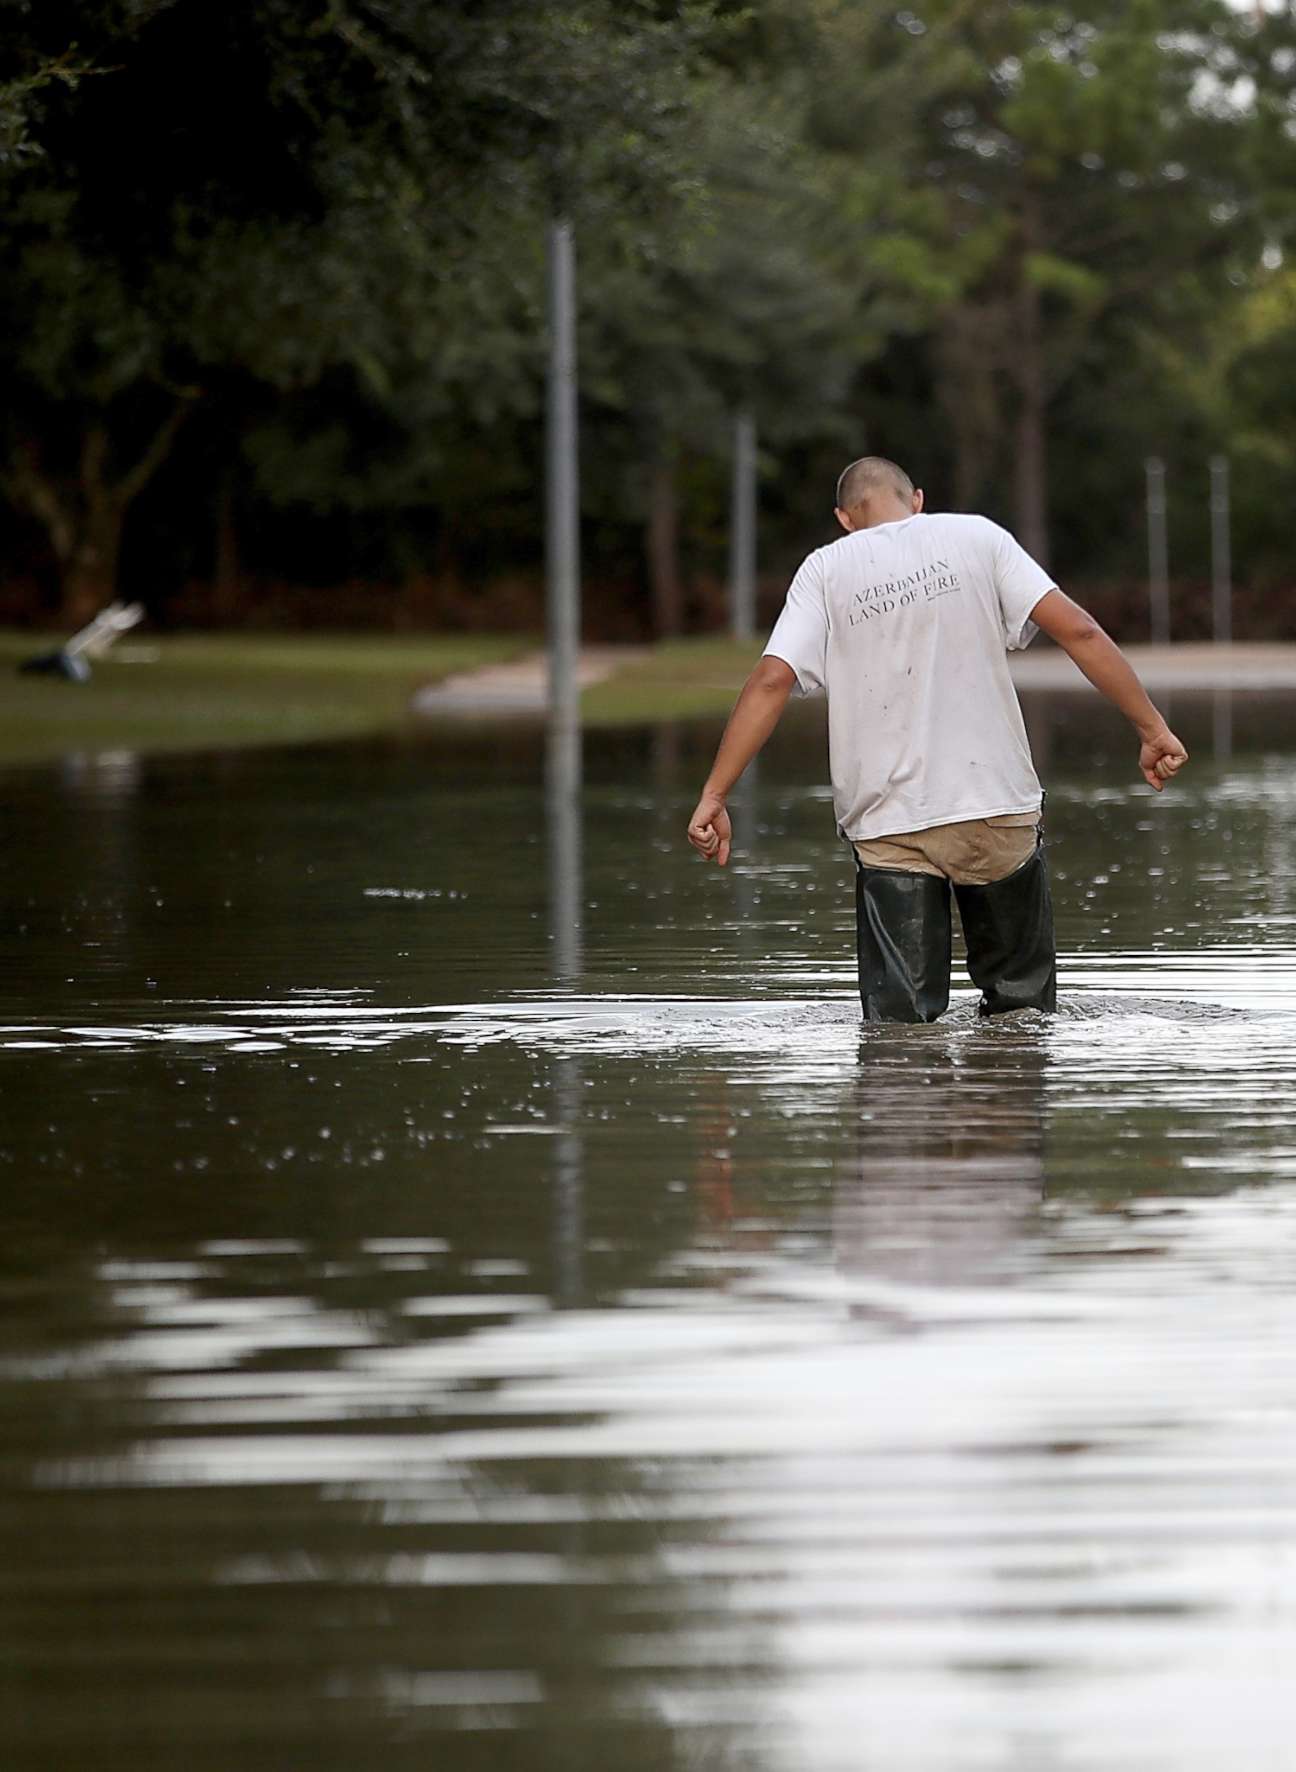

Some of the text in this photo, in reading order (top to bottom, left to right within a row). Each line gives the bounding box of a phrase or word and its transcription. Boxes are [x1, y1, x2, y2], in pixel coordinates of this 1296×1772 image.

[853, 558, 950, 604] AZERBAIJAN
[849, 599, 895, 626] LAND
[900, 588, 919, 607] OF
